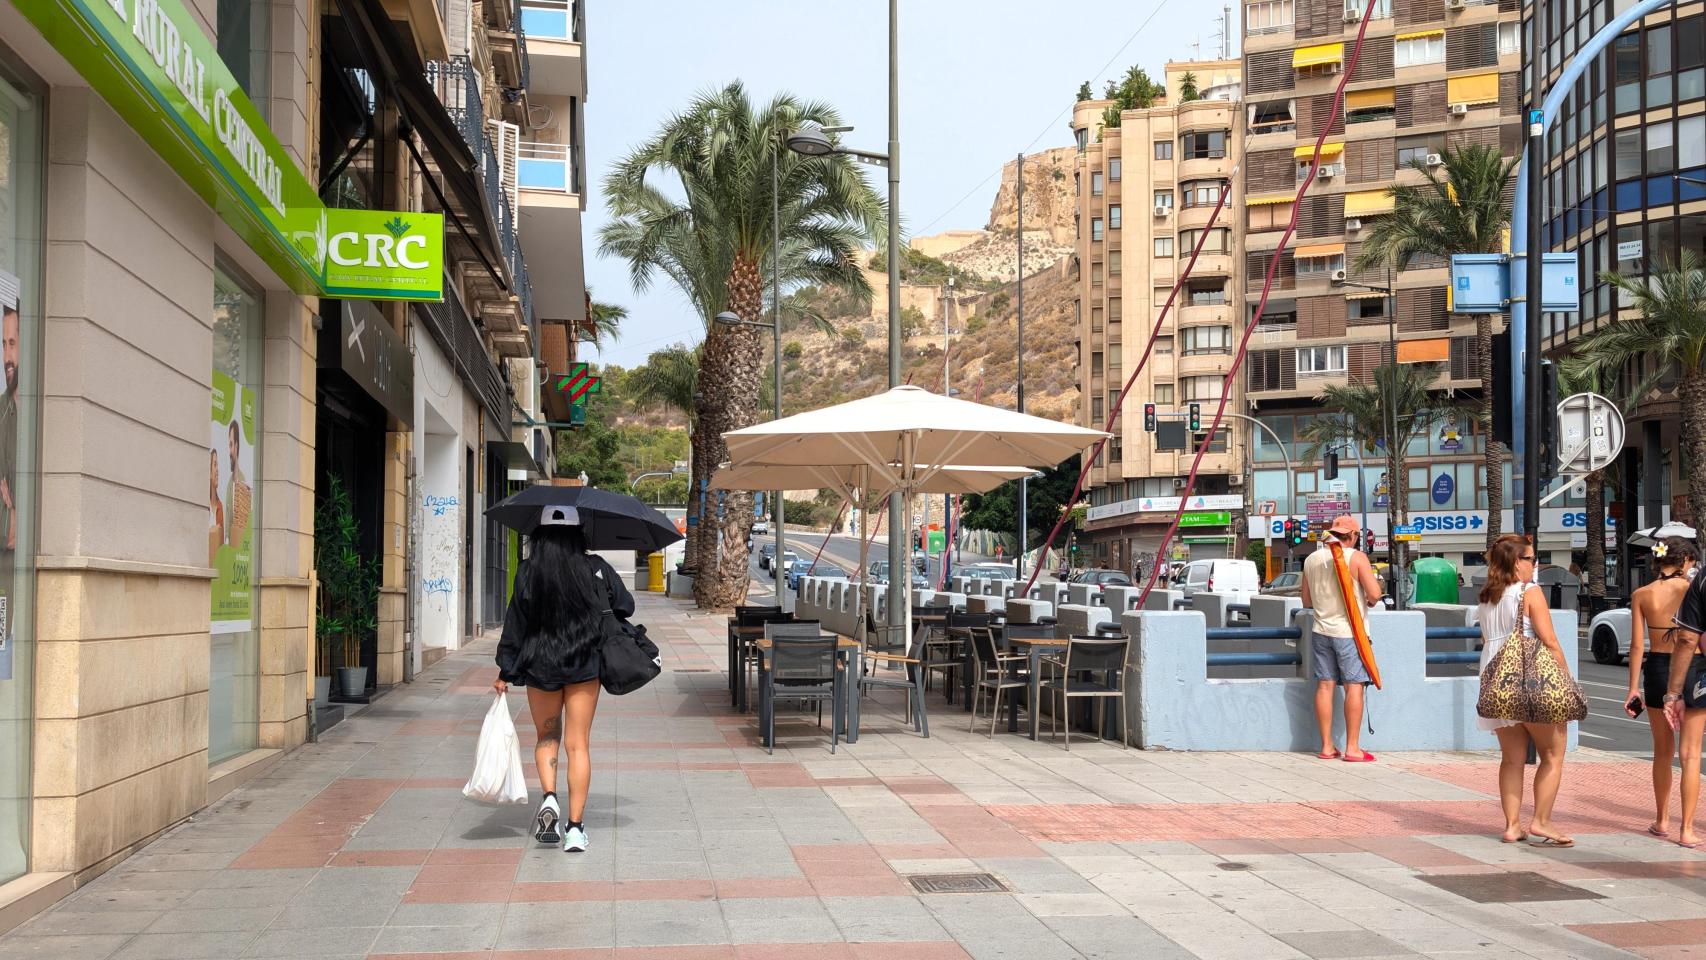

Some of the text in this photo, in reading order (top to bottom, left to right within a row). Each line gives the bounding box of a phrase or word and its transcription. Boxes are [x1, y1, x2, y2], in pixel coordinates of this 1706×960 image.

[133, 0, 286, 218] RURAL CENTRAL
[328, 231, 430, 269] CRC
[1412, 515, 1467, 531] asisa
